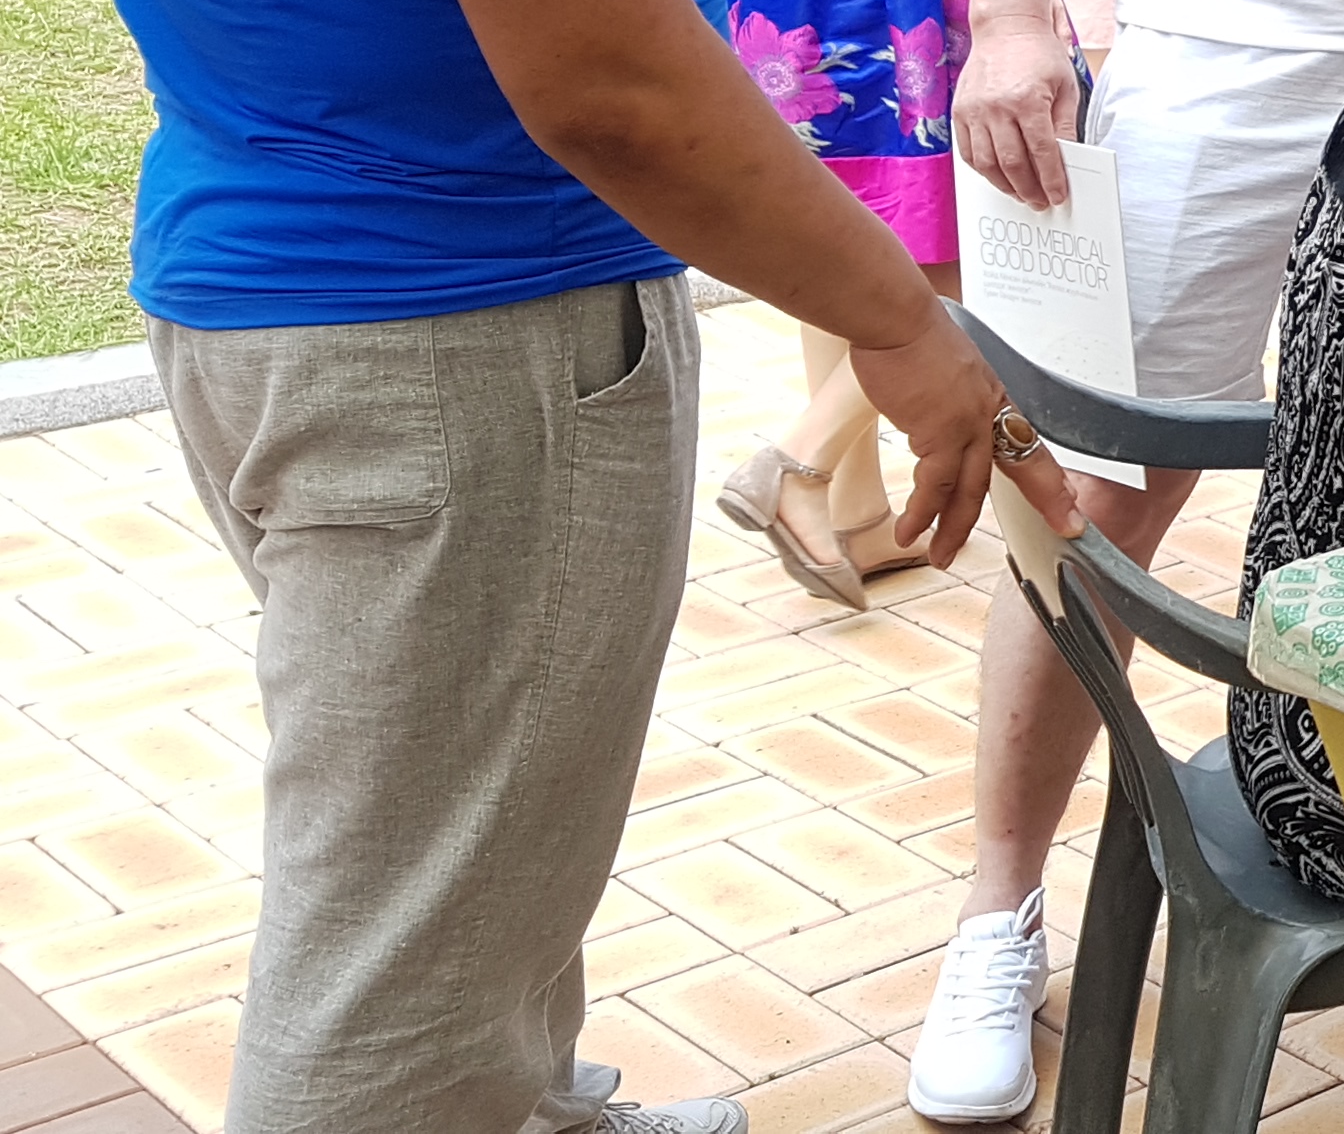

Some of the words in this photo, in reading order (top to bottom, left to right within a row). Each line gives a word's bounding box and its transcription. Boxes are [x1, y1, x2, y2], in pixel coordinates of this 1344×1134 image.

[979, 216, 1032, 247] GOOD
[1037, 226, 1111, 267] MEDICAL
[981, 241, 1034, 272] GOOD
[1039, 252, 1109, 291] DOCTOR
